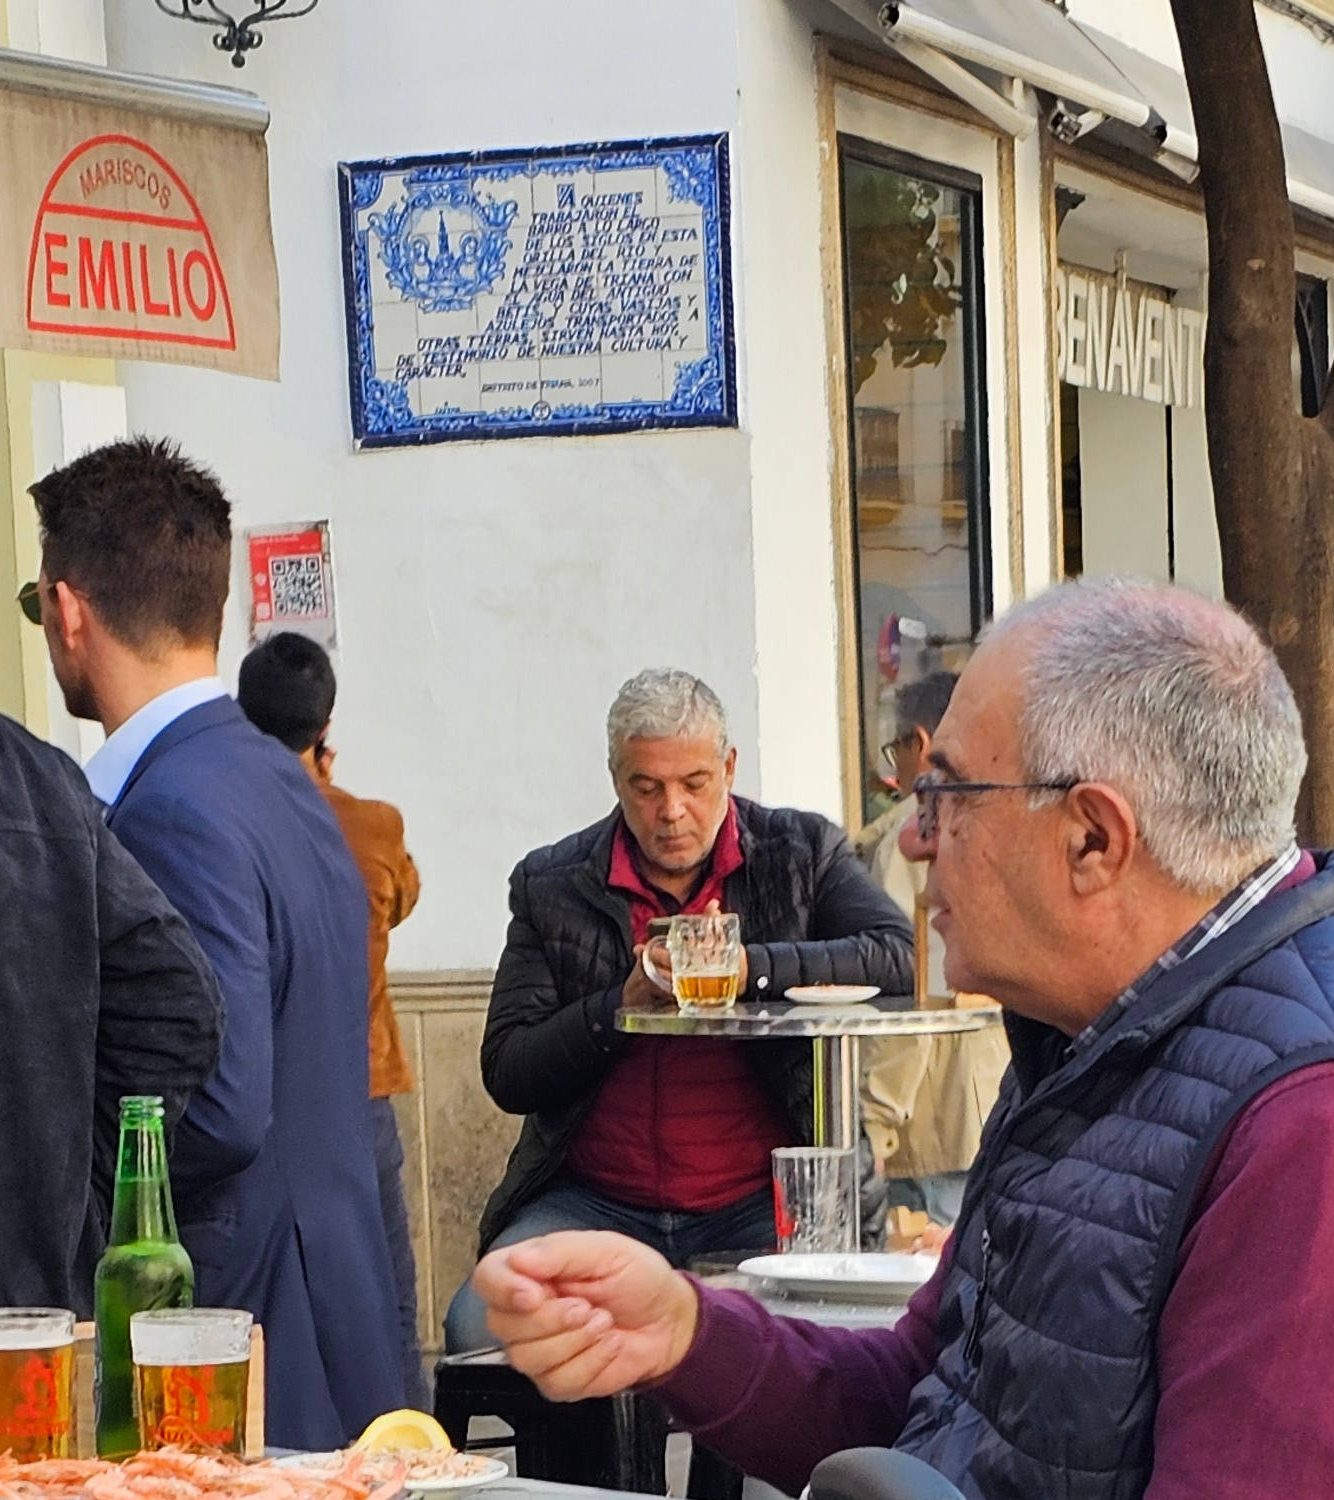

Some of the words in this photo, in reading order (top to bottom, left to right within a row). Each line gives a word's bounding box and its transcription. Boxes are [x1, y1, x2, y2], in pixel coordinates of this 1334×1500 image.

[79, 158, 173, 211] MARISCOS
[581, 192, 643, 208] QUIENES
[532, 208, 619, 224] TRABAJARON
[623, 205, 641, 218] EL
[578, 221, 587, 235] A
[595, 220, 613, 233] LO
[617, 217, 660, 233] LARGO
[526, 238, 544, 251] DE
[550, 236, 574, 249] LOS
[582, 232, 634, 247] SIGLOS
[662, 229, 698, 242] ESTA
[524, 249, 575, 264] ORILLA
[581, 244, 608, 260] DEL
[654, 243, 663, 257] Y
[598, 261, 614, 273] LA
[623, 257, 673, 271] TIERRA
[680, 254, 699, 267] DE
[44, 231, 218, 322] EMILIO
[511, 280, 528, 294] LA
[534, 278, 569, 292] VEGA
[575, 276, 595, 290] DE
[604, 272, 655, 288] TRIANA
[664, 270, 693, 282] CON
[571, 289, 596, 302] DEL
[606, 284, 670, 300] ANTIGUO
[570, 300, 612, 315] CUYAS
[621, 297, 681, 313] VASIJAS
[688, 295, 697, 308] Y
[485, 317, 555, 333] AZULEJOS
[568, 311, 679, 329] TRANSPORTADOS
[688, 308, 699, 321] A
[419, 337, 461, 352] OTRAS
[542, 328, 595, 343] SIRVEN
[599, 326, 644, 341] HASTA
[397, 354, 415, 367] DE
[423, 347, 509, 365] TESTIMONIO
[518, 345, 535, 358] DE
[541, 341, 602, 357] NUESTRA
[612, 338, 672, 352] CULTURA
[680, 335, 689, 349] Y
